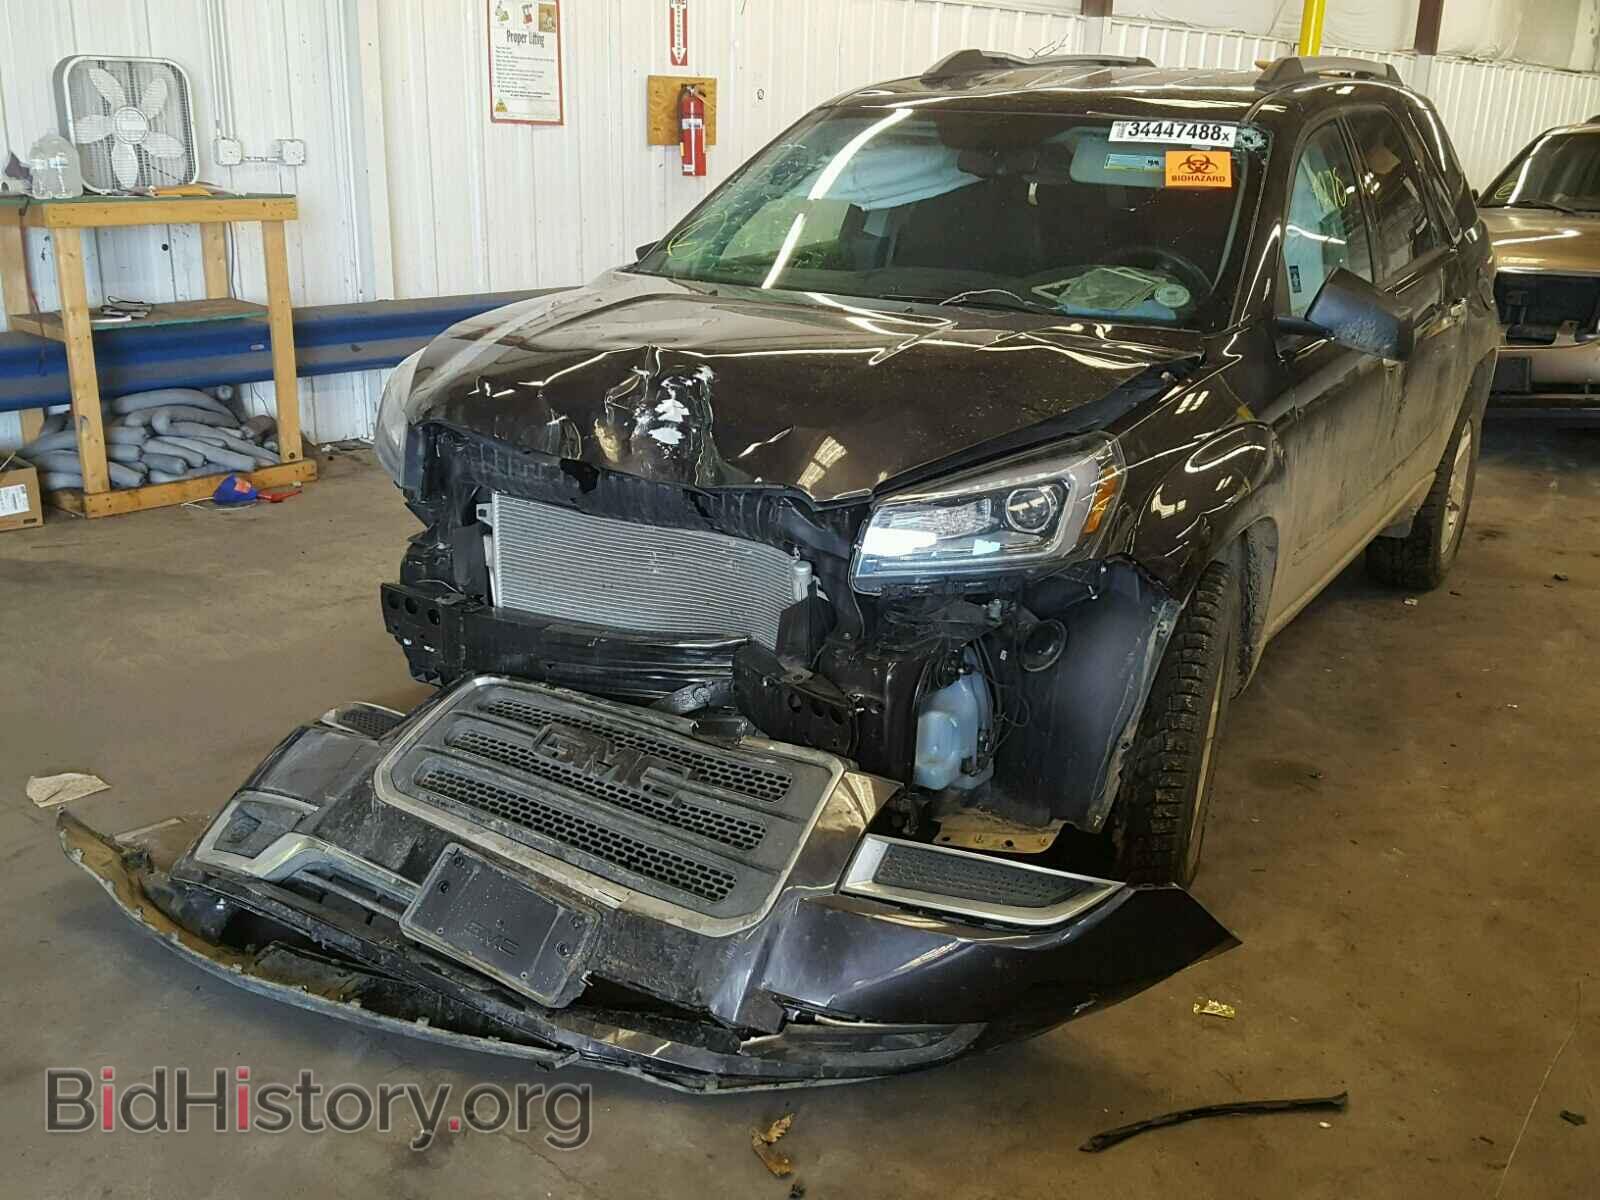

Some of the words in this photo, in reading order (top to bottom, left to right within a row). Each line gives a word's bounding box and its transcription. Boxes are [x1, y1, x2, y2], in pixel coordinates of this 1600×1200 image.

[506, 29, 528, 46] Proper
[528, 32, 545, 48] Lifting
[1171, 175, 1226, 183] BIOHAZARD
[532, 722, 691, 807] GMC
[464, 920, 520, 959] GMC
